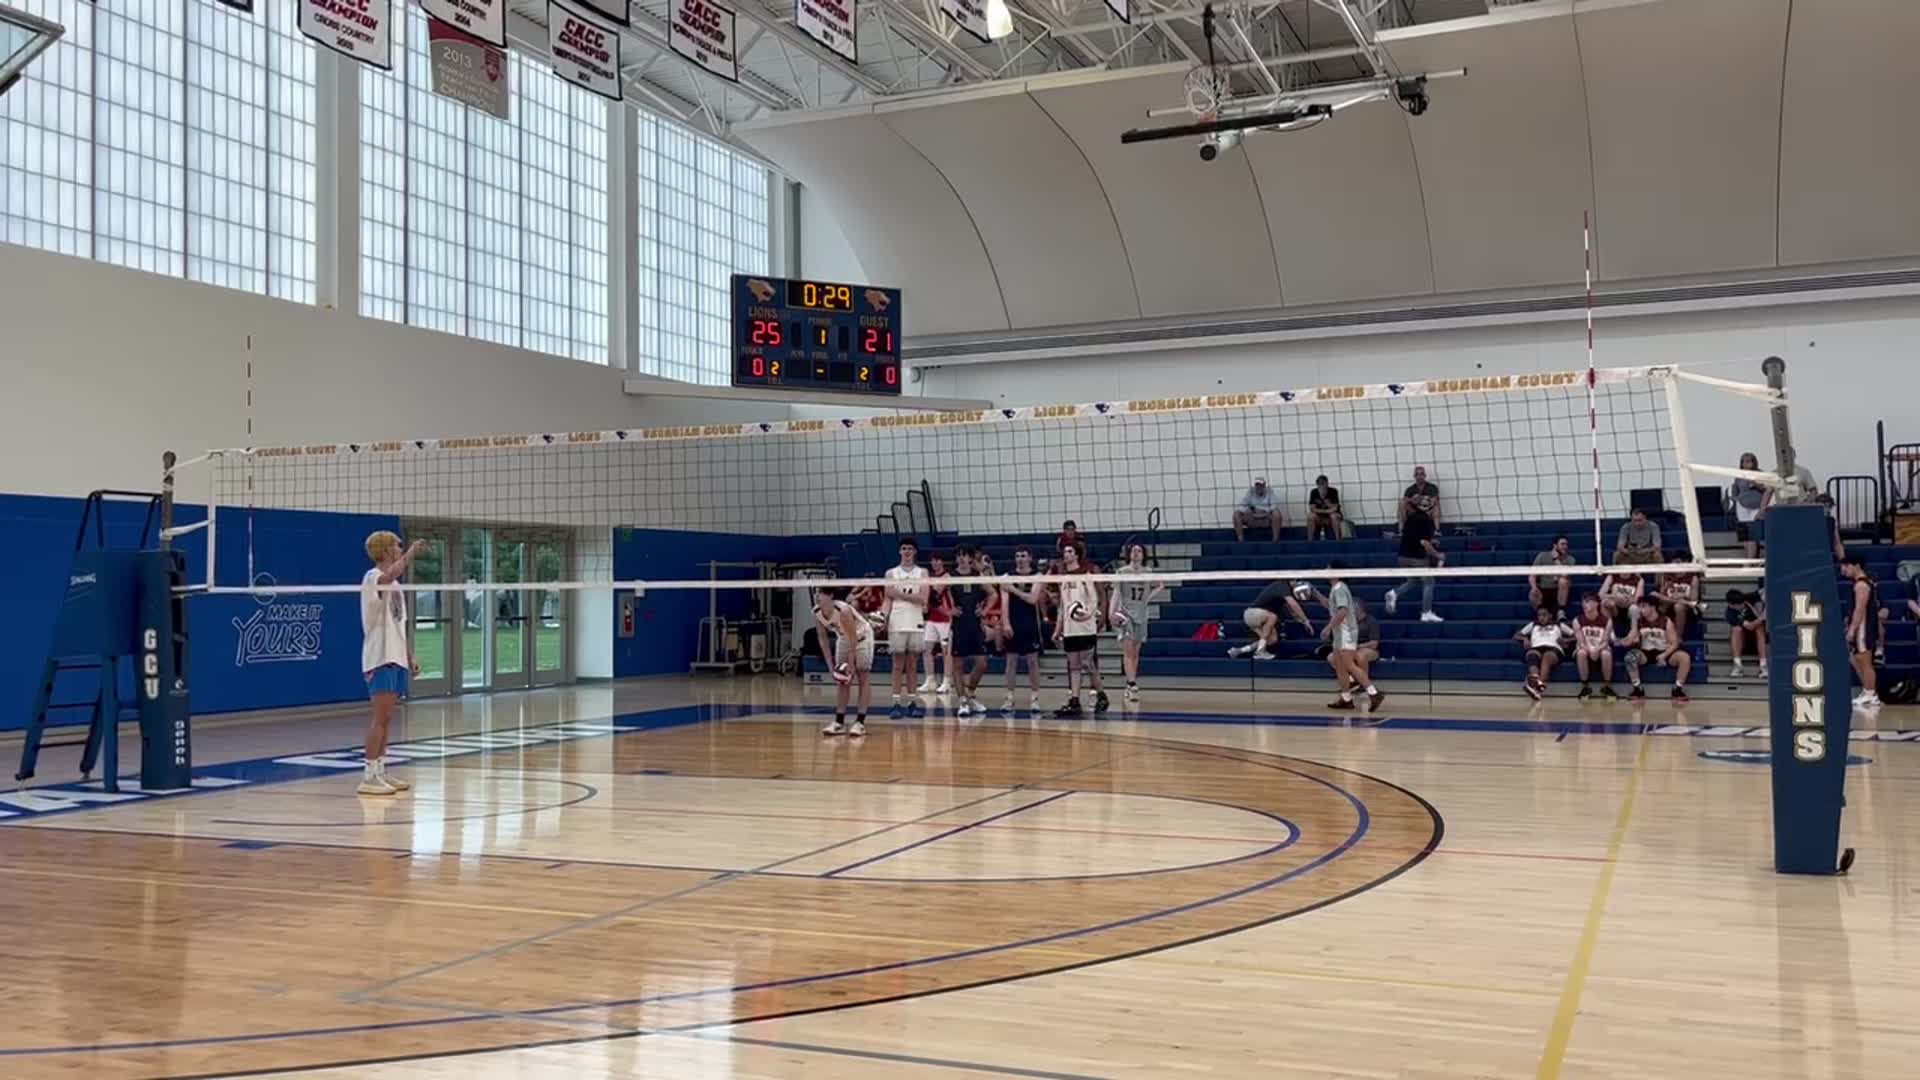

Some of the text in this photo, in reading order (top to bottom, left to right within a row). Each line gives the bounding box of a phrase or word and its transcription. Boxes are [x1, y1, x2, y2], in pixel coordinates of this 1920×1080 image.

[443, 46, 472, 68] 2013
[803, 284, 850, 309] 0:29
[753, 321, 780, 345] 25
[865, 329, 891, 352] 21
[752, 358, 764, 376] 0
[770, 361, 780, 375] 2
[860, 367, 869, 380] 2
[886, 367, 896, 384] 0
[1131, 587, 1145, 601] 17
[266, 604, 324, 621] MAKE IT
[144, 628, 160, 699] GCU
[1791, 591, 1825, 762] LIONS
